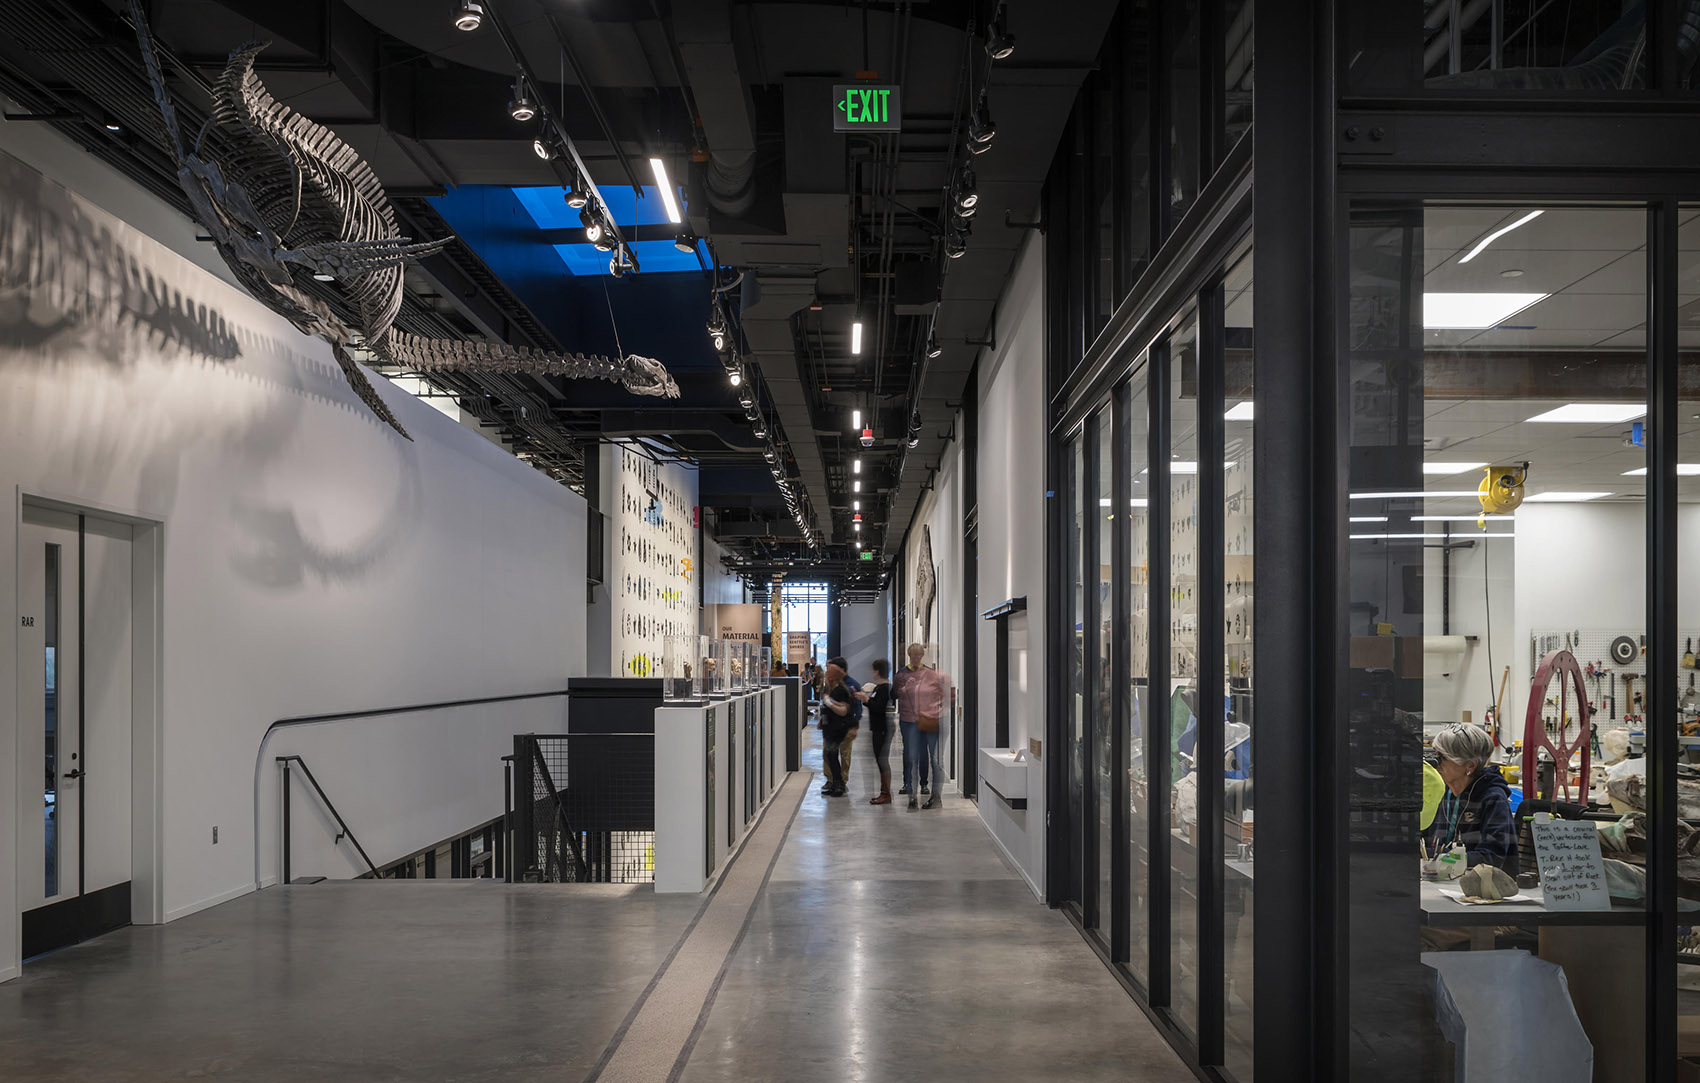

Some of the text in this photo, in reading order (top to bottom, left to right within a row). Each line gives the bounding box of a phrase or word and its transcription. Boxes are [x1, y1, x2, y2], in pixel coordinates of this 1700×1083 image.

[846, 89, 890, 122] EXIT
[21, 616, 35, 627] RAR
[722, 632, 759, 640] MATERIAL
